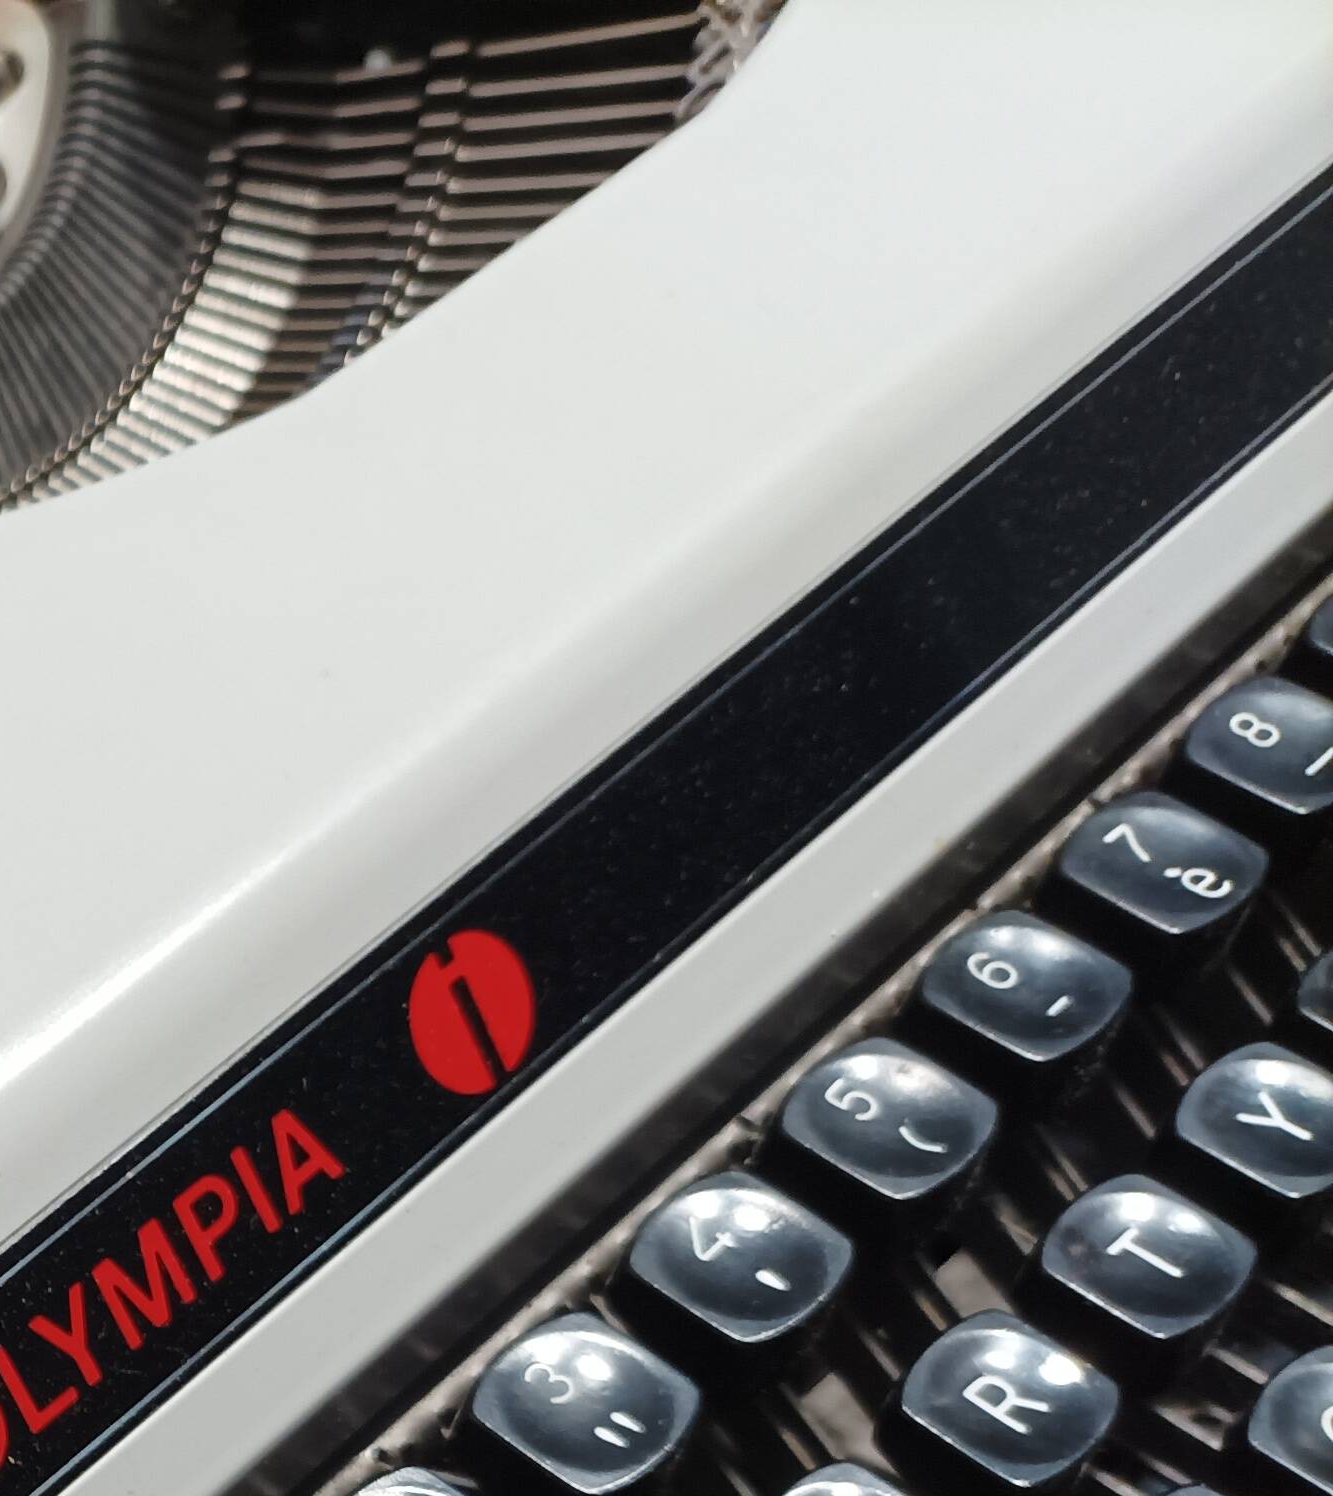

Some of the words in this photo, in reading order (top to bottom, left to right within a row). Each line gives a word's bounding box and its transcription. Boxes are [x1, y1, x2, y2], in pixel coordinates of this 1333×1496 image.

[1229, 712, 1282, 748] 8
[1104, 823, 1152, 863] 7
[967, 951, 1019, 990] 6
[824, 1077, 882, 1122] 5
[1235, 1091, 1314, 1143] Y
[689, 1215, 737, 1262] 4
[1105, 1228, 1185, 1279] T
[524, 1361, 572, 1405] 3
[961, 1374, 1049, 1436] R
